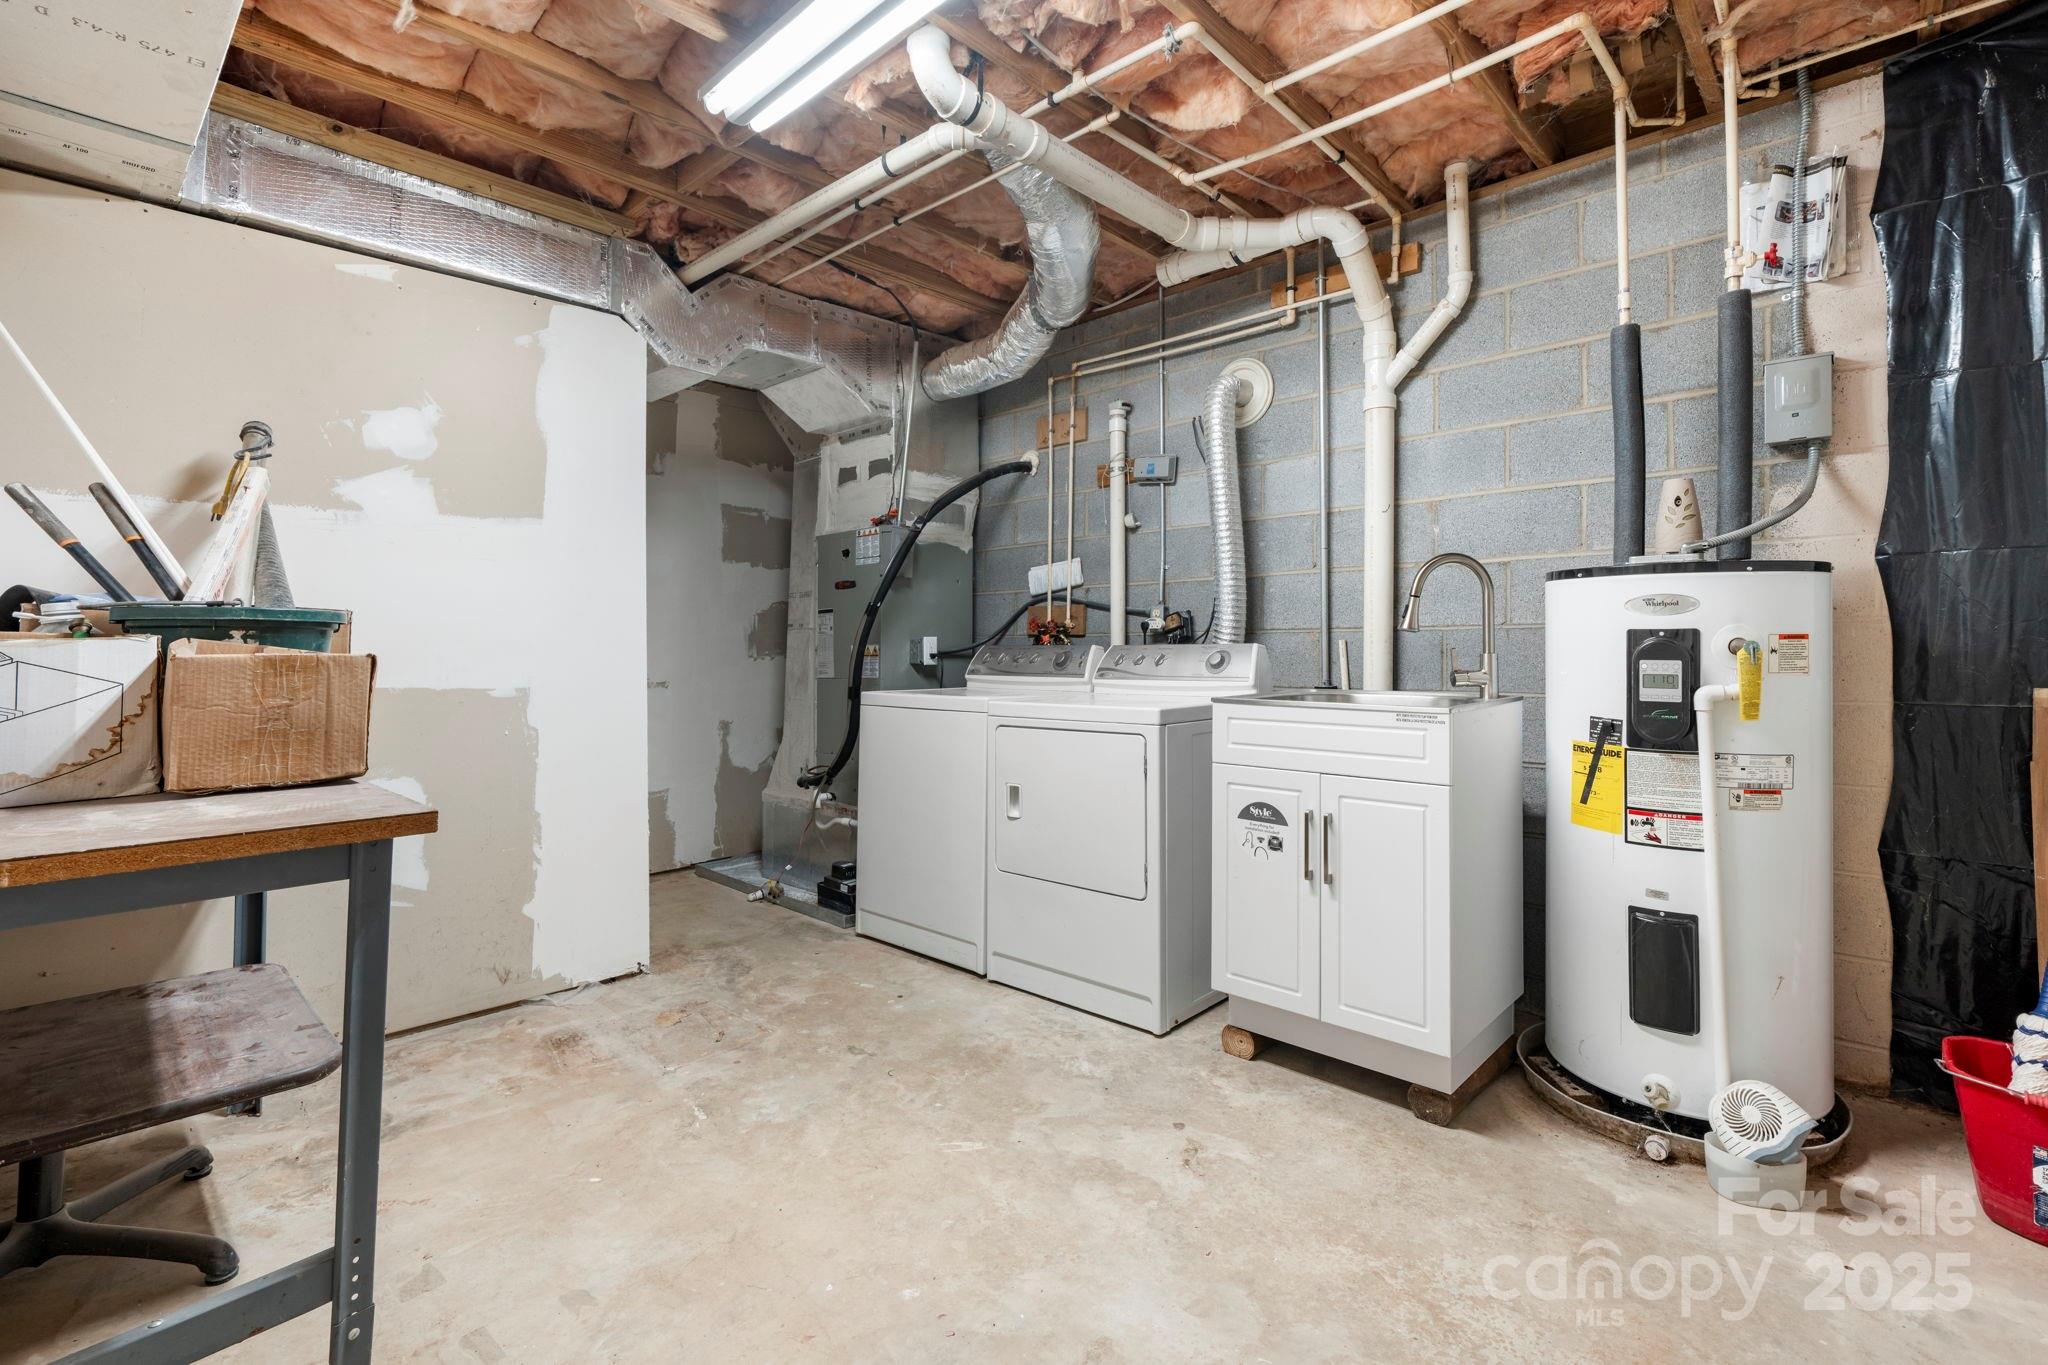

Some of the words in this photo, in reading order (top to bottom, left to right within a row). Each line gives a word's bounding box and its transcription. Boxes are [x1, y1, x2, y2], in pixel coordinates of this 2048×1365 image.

[1645, 600, 1679, 608] Whirlpool
[1572, 744, 1622, 758] ENERGUIDE
[1249, 805, 1272, 817] Style
